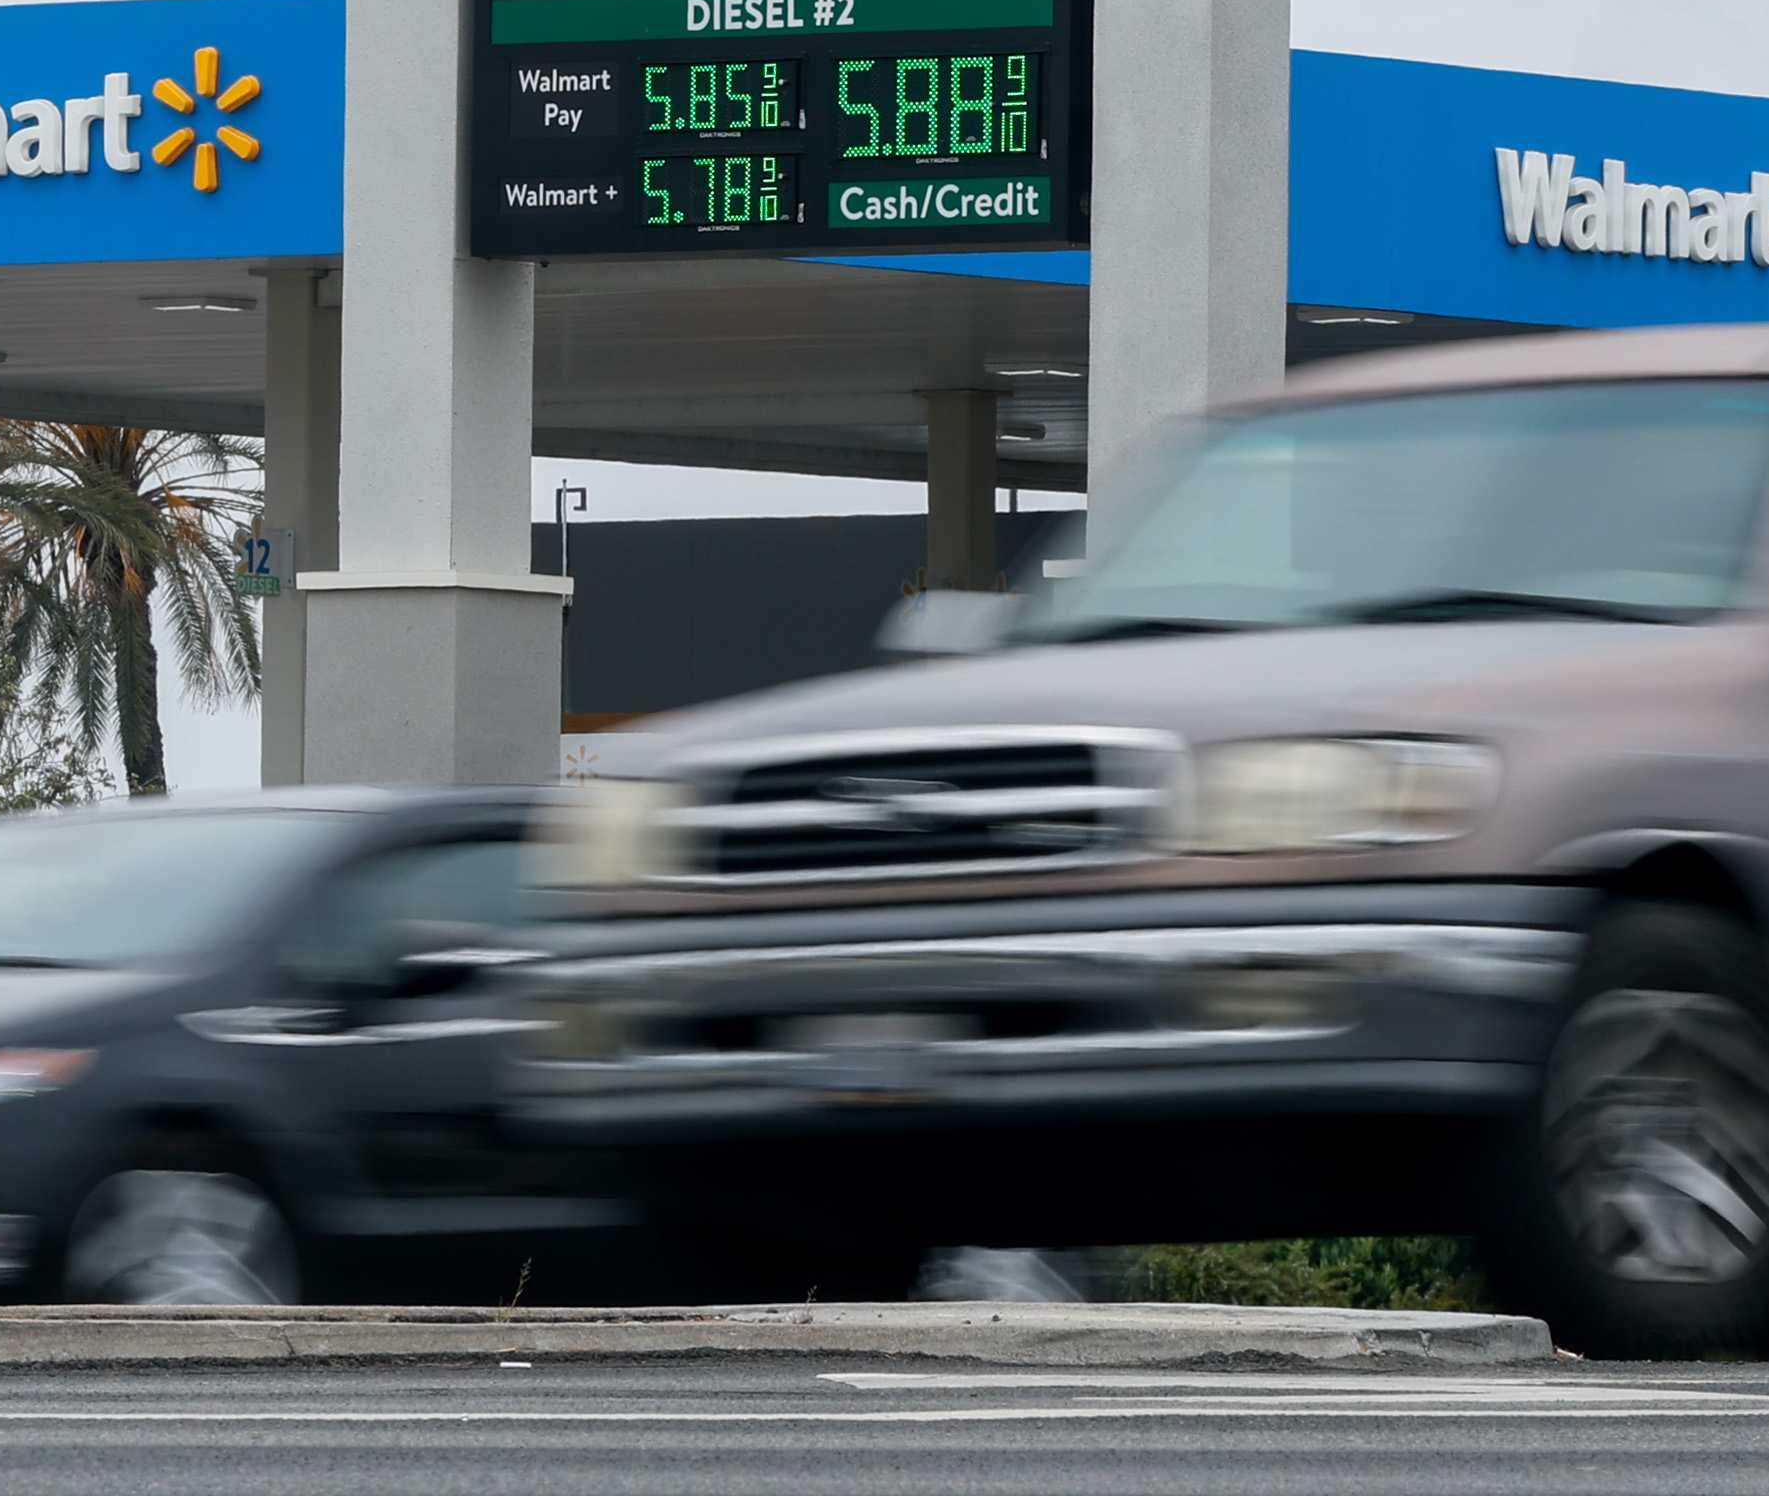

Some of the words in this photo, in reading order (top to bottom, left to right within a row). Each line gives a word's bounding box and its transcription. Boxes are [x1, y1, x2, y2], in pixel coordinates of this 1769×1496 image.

[518, 69, 612, 93] Walmart
[645, 64, 752, 131] 5.85
[543, 104, 583, 132] Pay
[838, 56, 994, 158] 5.88
[505, 184, 599, 208] Walmart
[643, 158, 751, 224] 5.78
[839, 183, 1040, 221] Cash/Credit
[244, 538, 270, 574] 12
[237, 577, 280, 594] DIESEL
